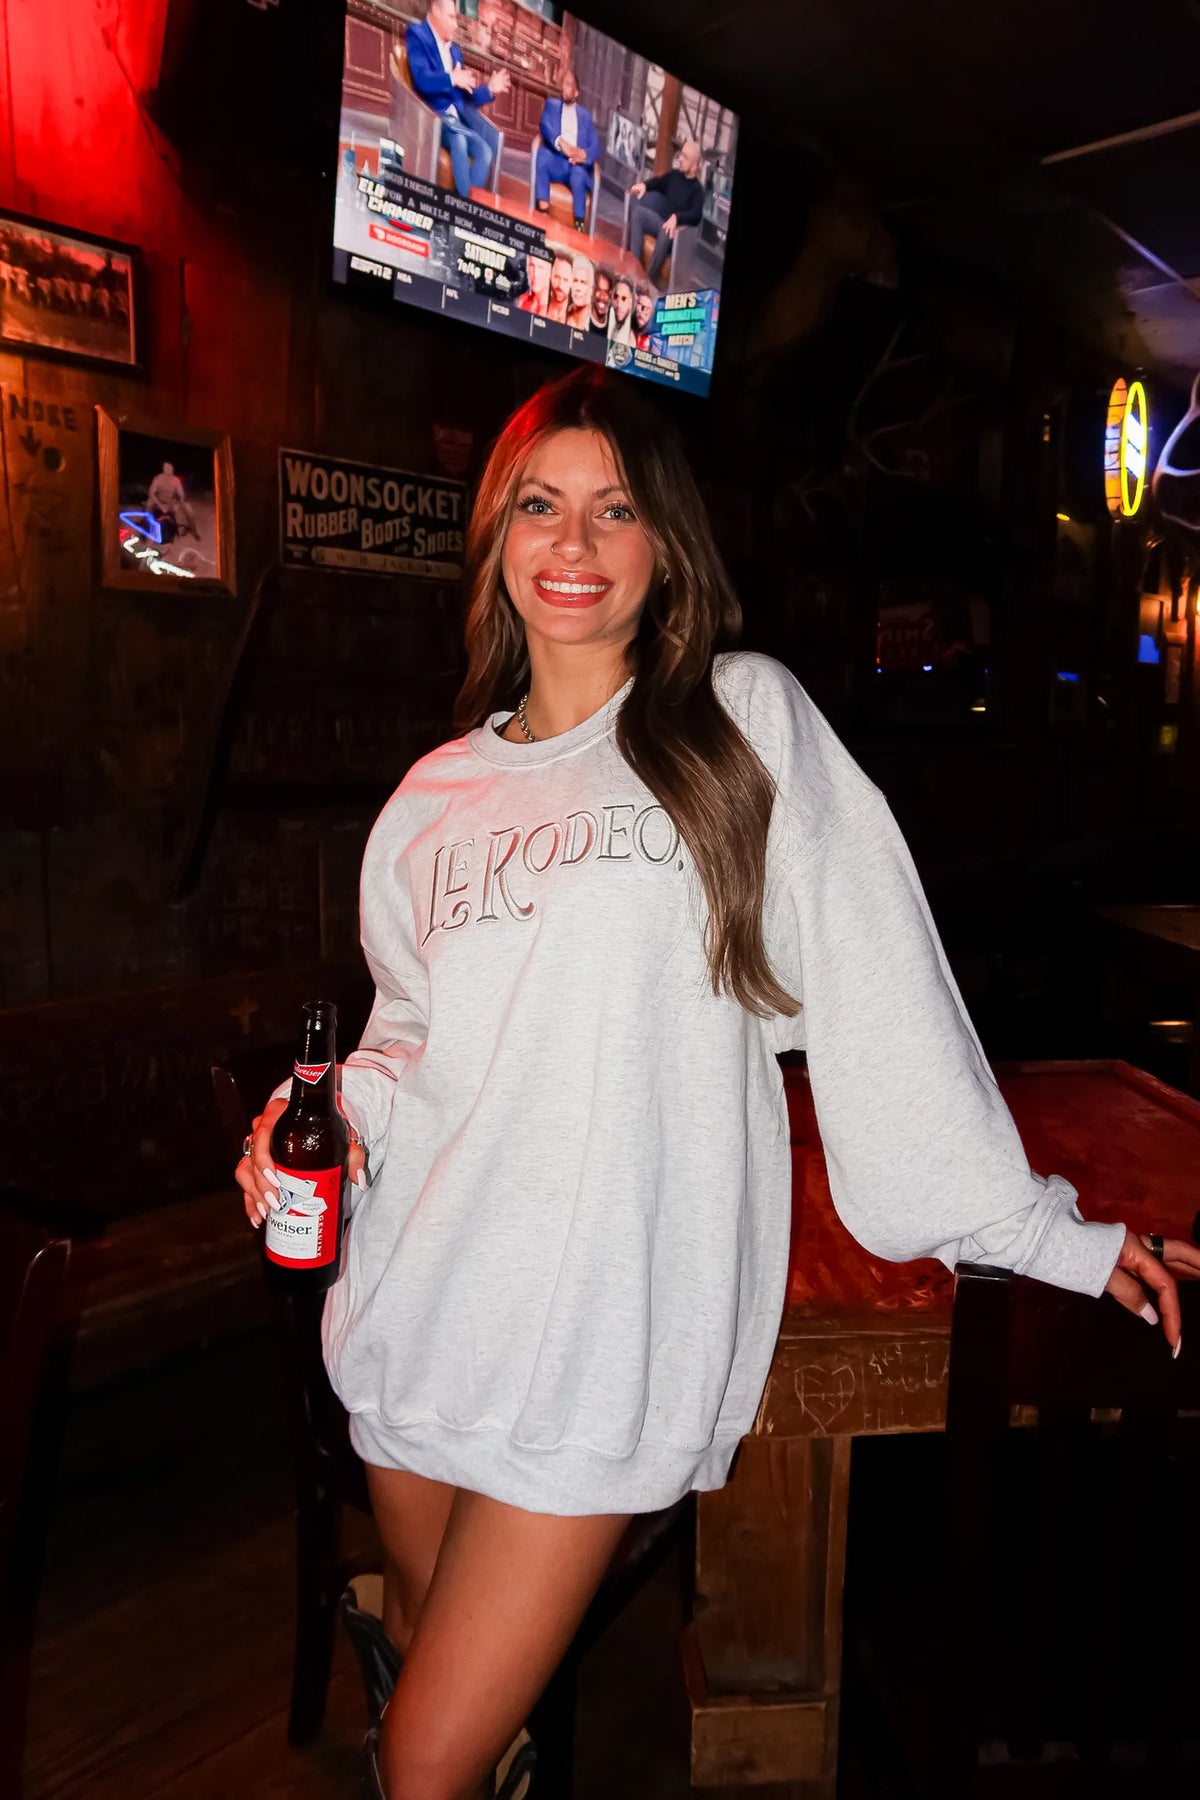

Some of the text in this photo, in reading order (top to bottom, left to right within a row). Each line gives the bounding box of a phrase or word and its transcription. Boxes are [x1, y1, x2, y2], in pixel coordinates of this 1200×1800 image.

[367, 195, 434, 231] CHAMBER
[408, 197, 415, 209] A
[464, 241, 507, 272] SATURDAY
[664, 291, 697, 310] MEN'S
[284, 457, 462, 522] WOONSOCKET
[286, 502, 465, 558] RUBBER BOOTS SHOES
